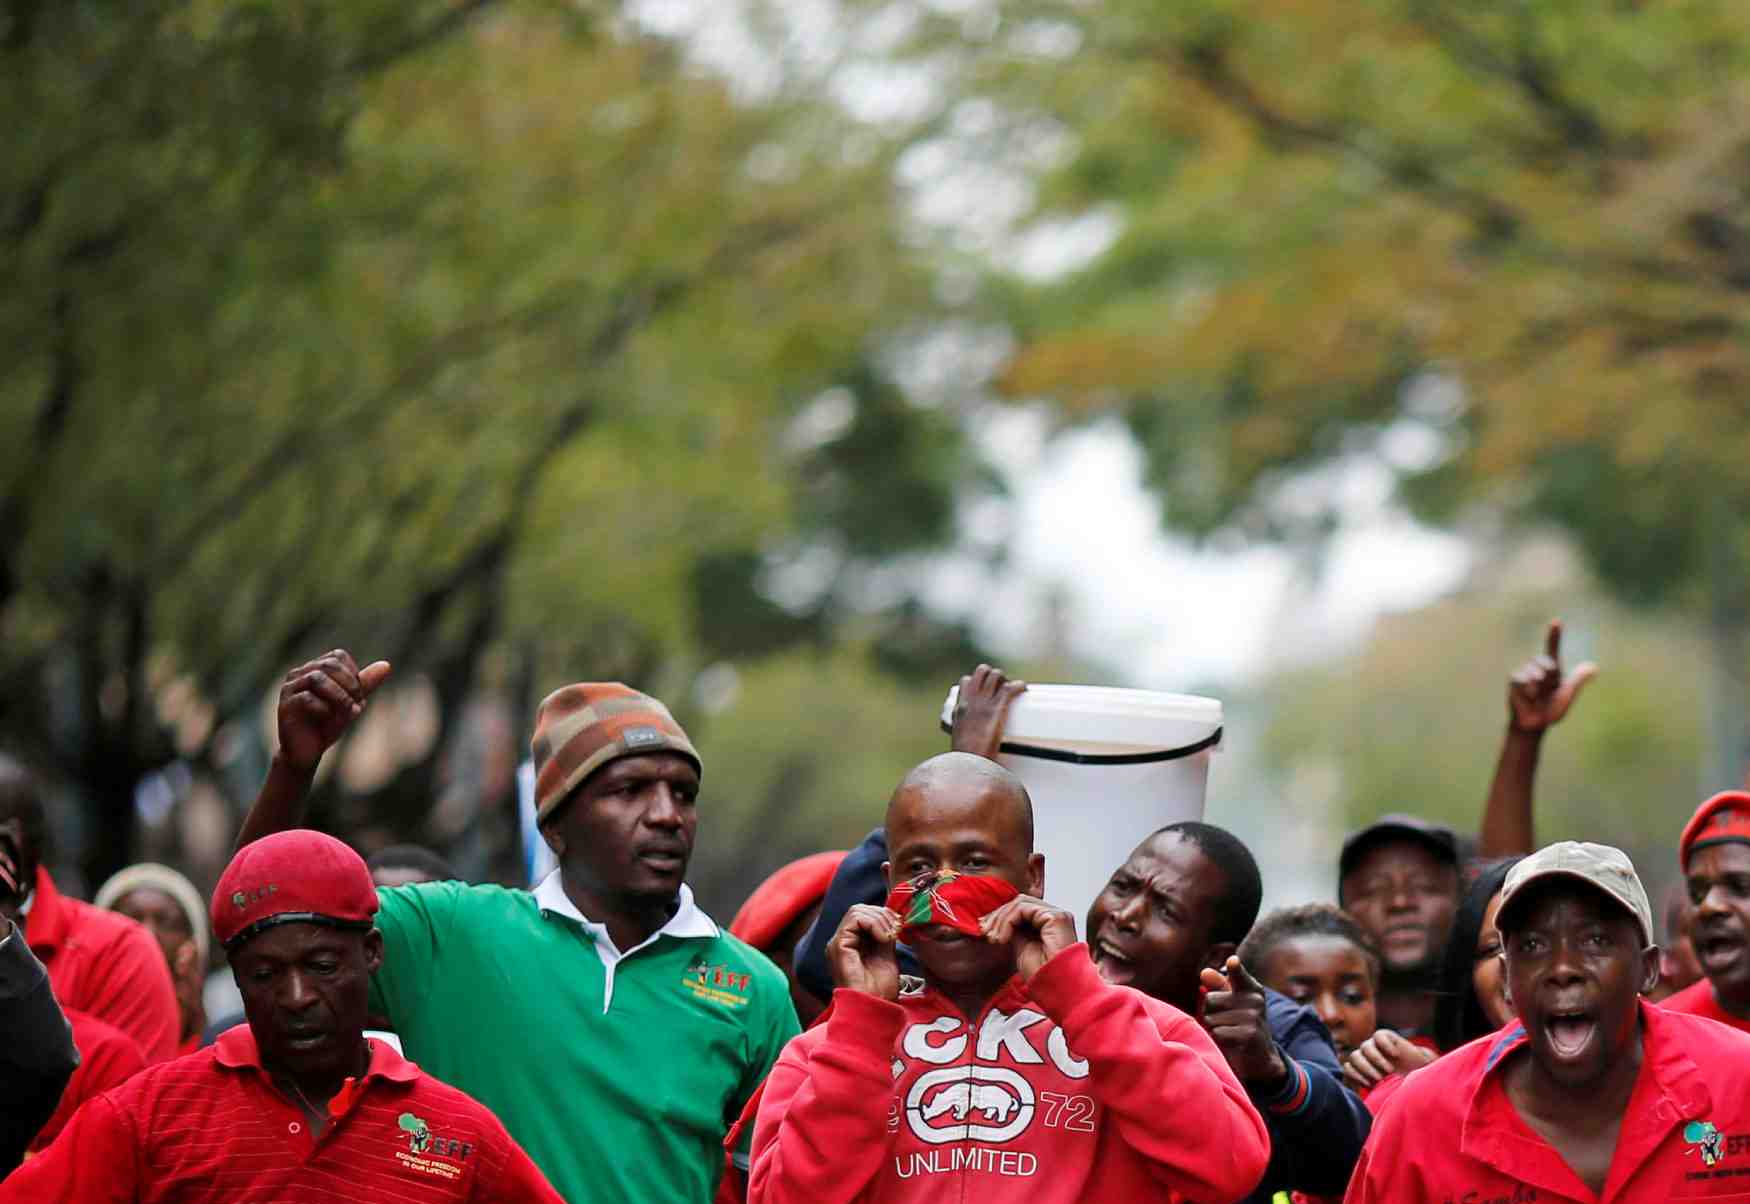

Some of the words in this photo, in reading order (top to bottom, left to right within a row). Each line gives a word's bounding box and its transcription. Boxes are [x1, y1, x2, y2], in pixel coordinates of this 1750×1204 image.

[1041, 1091, 1096, 1133] 72
[433, 1135, 473, 1161] EFF
[895, 1147, 1038, 1179] UNLIMITED
